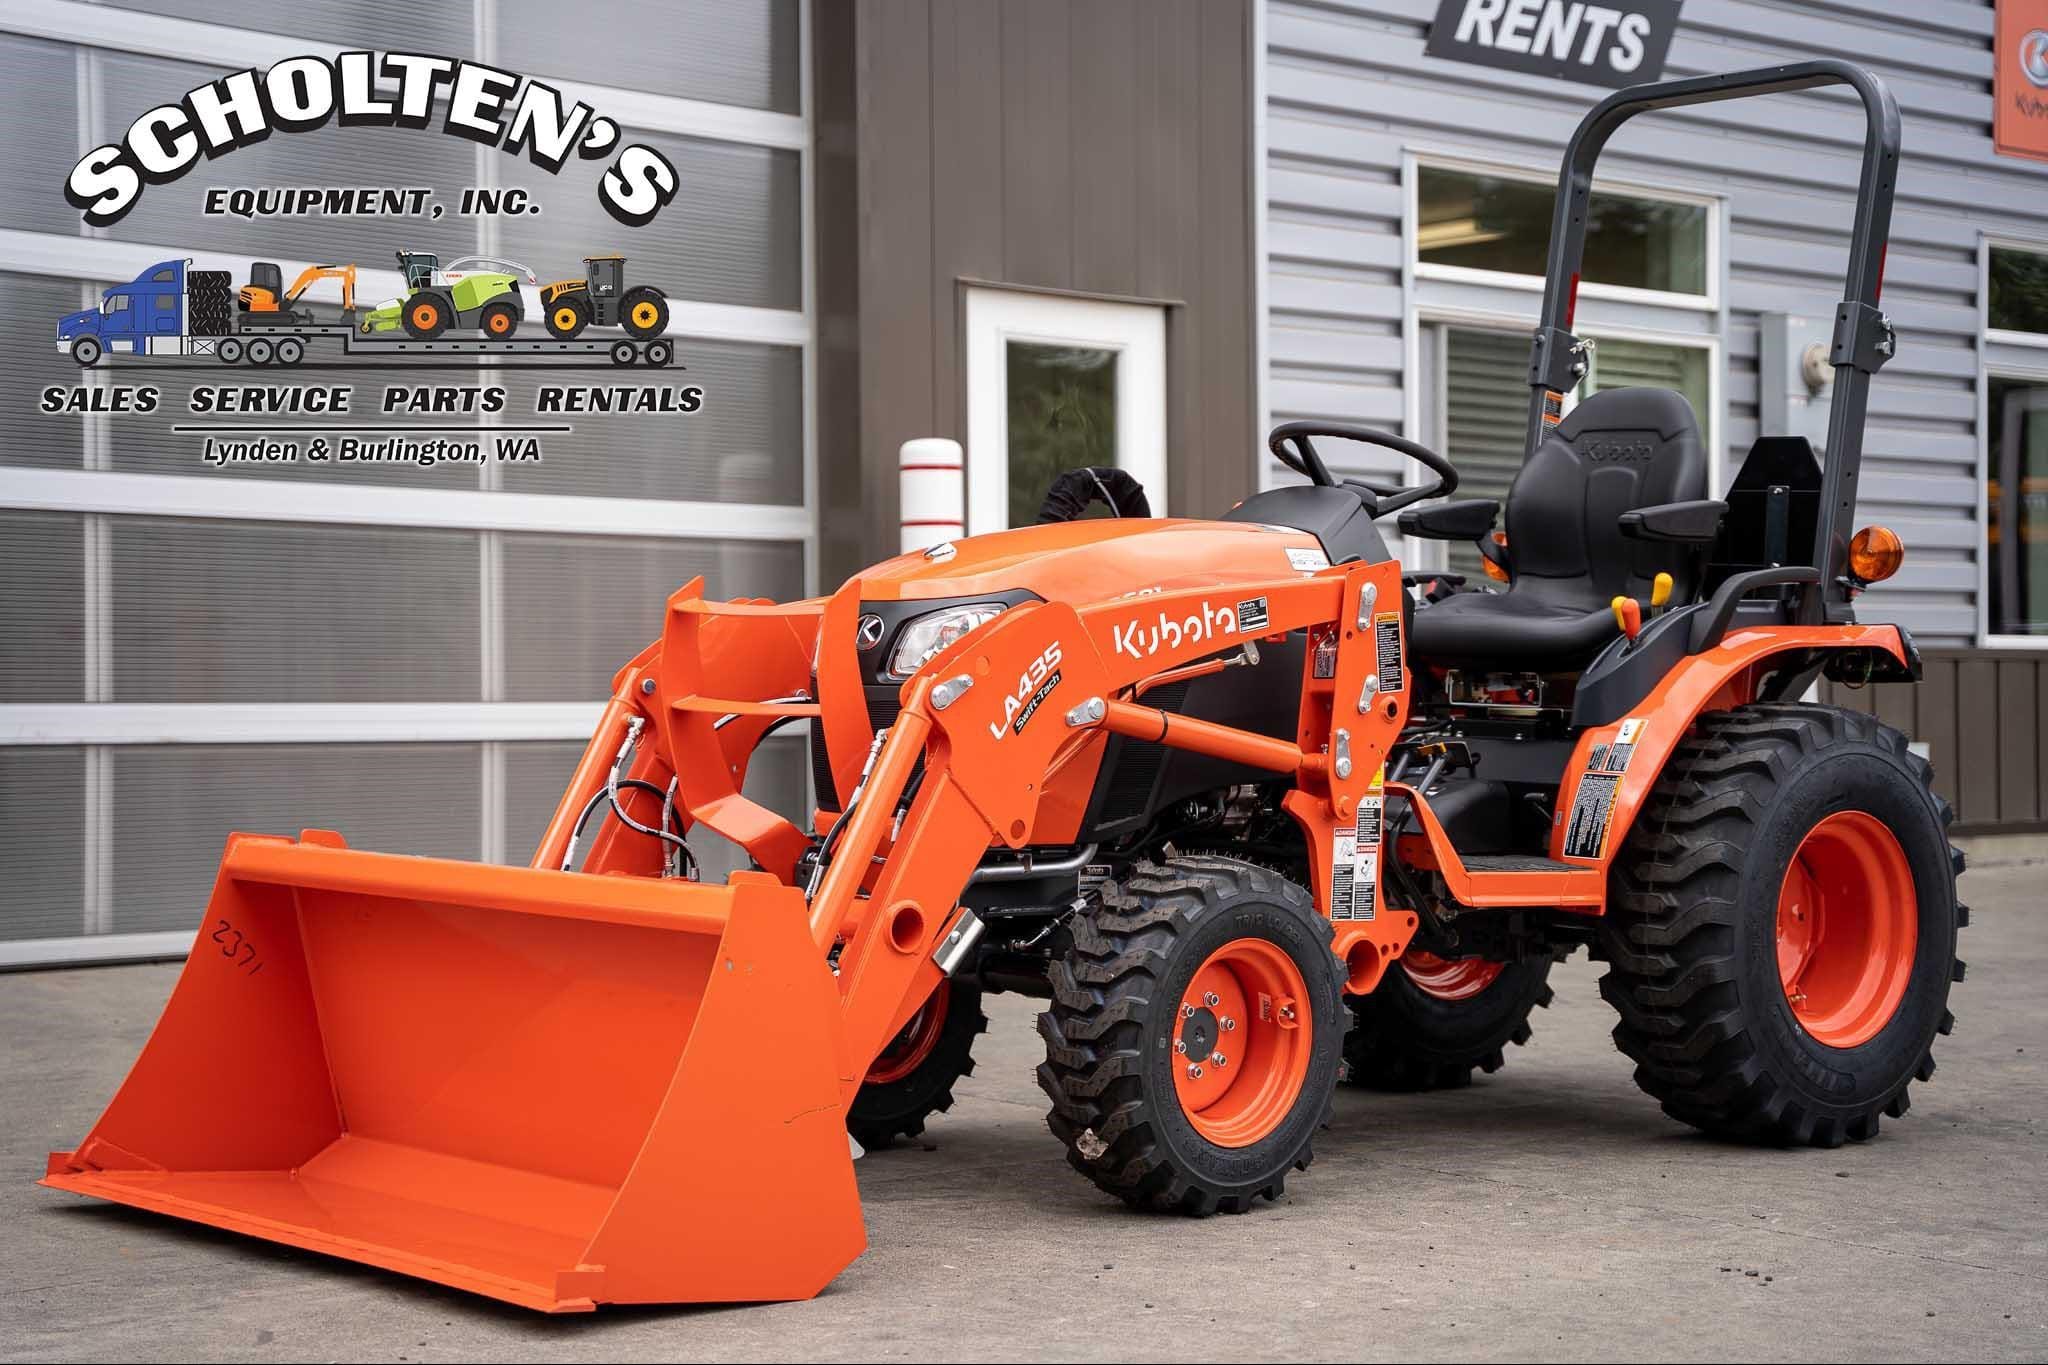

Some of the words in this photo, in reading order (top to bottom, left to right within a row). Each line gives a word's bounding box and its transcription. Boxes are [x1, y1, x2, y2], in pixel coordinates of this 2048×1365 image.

[1454, 0, 1651, 73] RENTS
[1112, 600, 1237, 661] Kubota
[988, 639, 1063, 741] LA435
[1015, 673, 1061, 732] Swift-Tach
[212, 919, 264, 976] 2371
